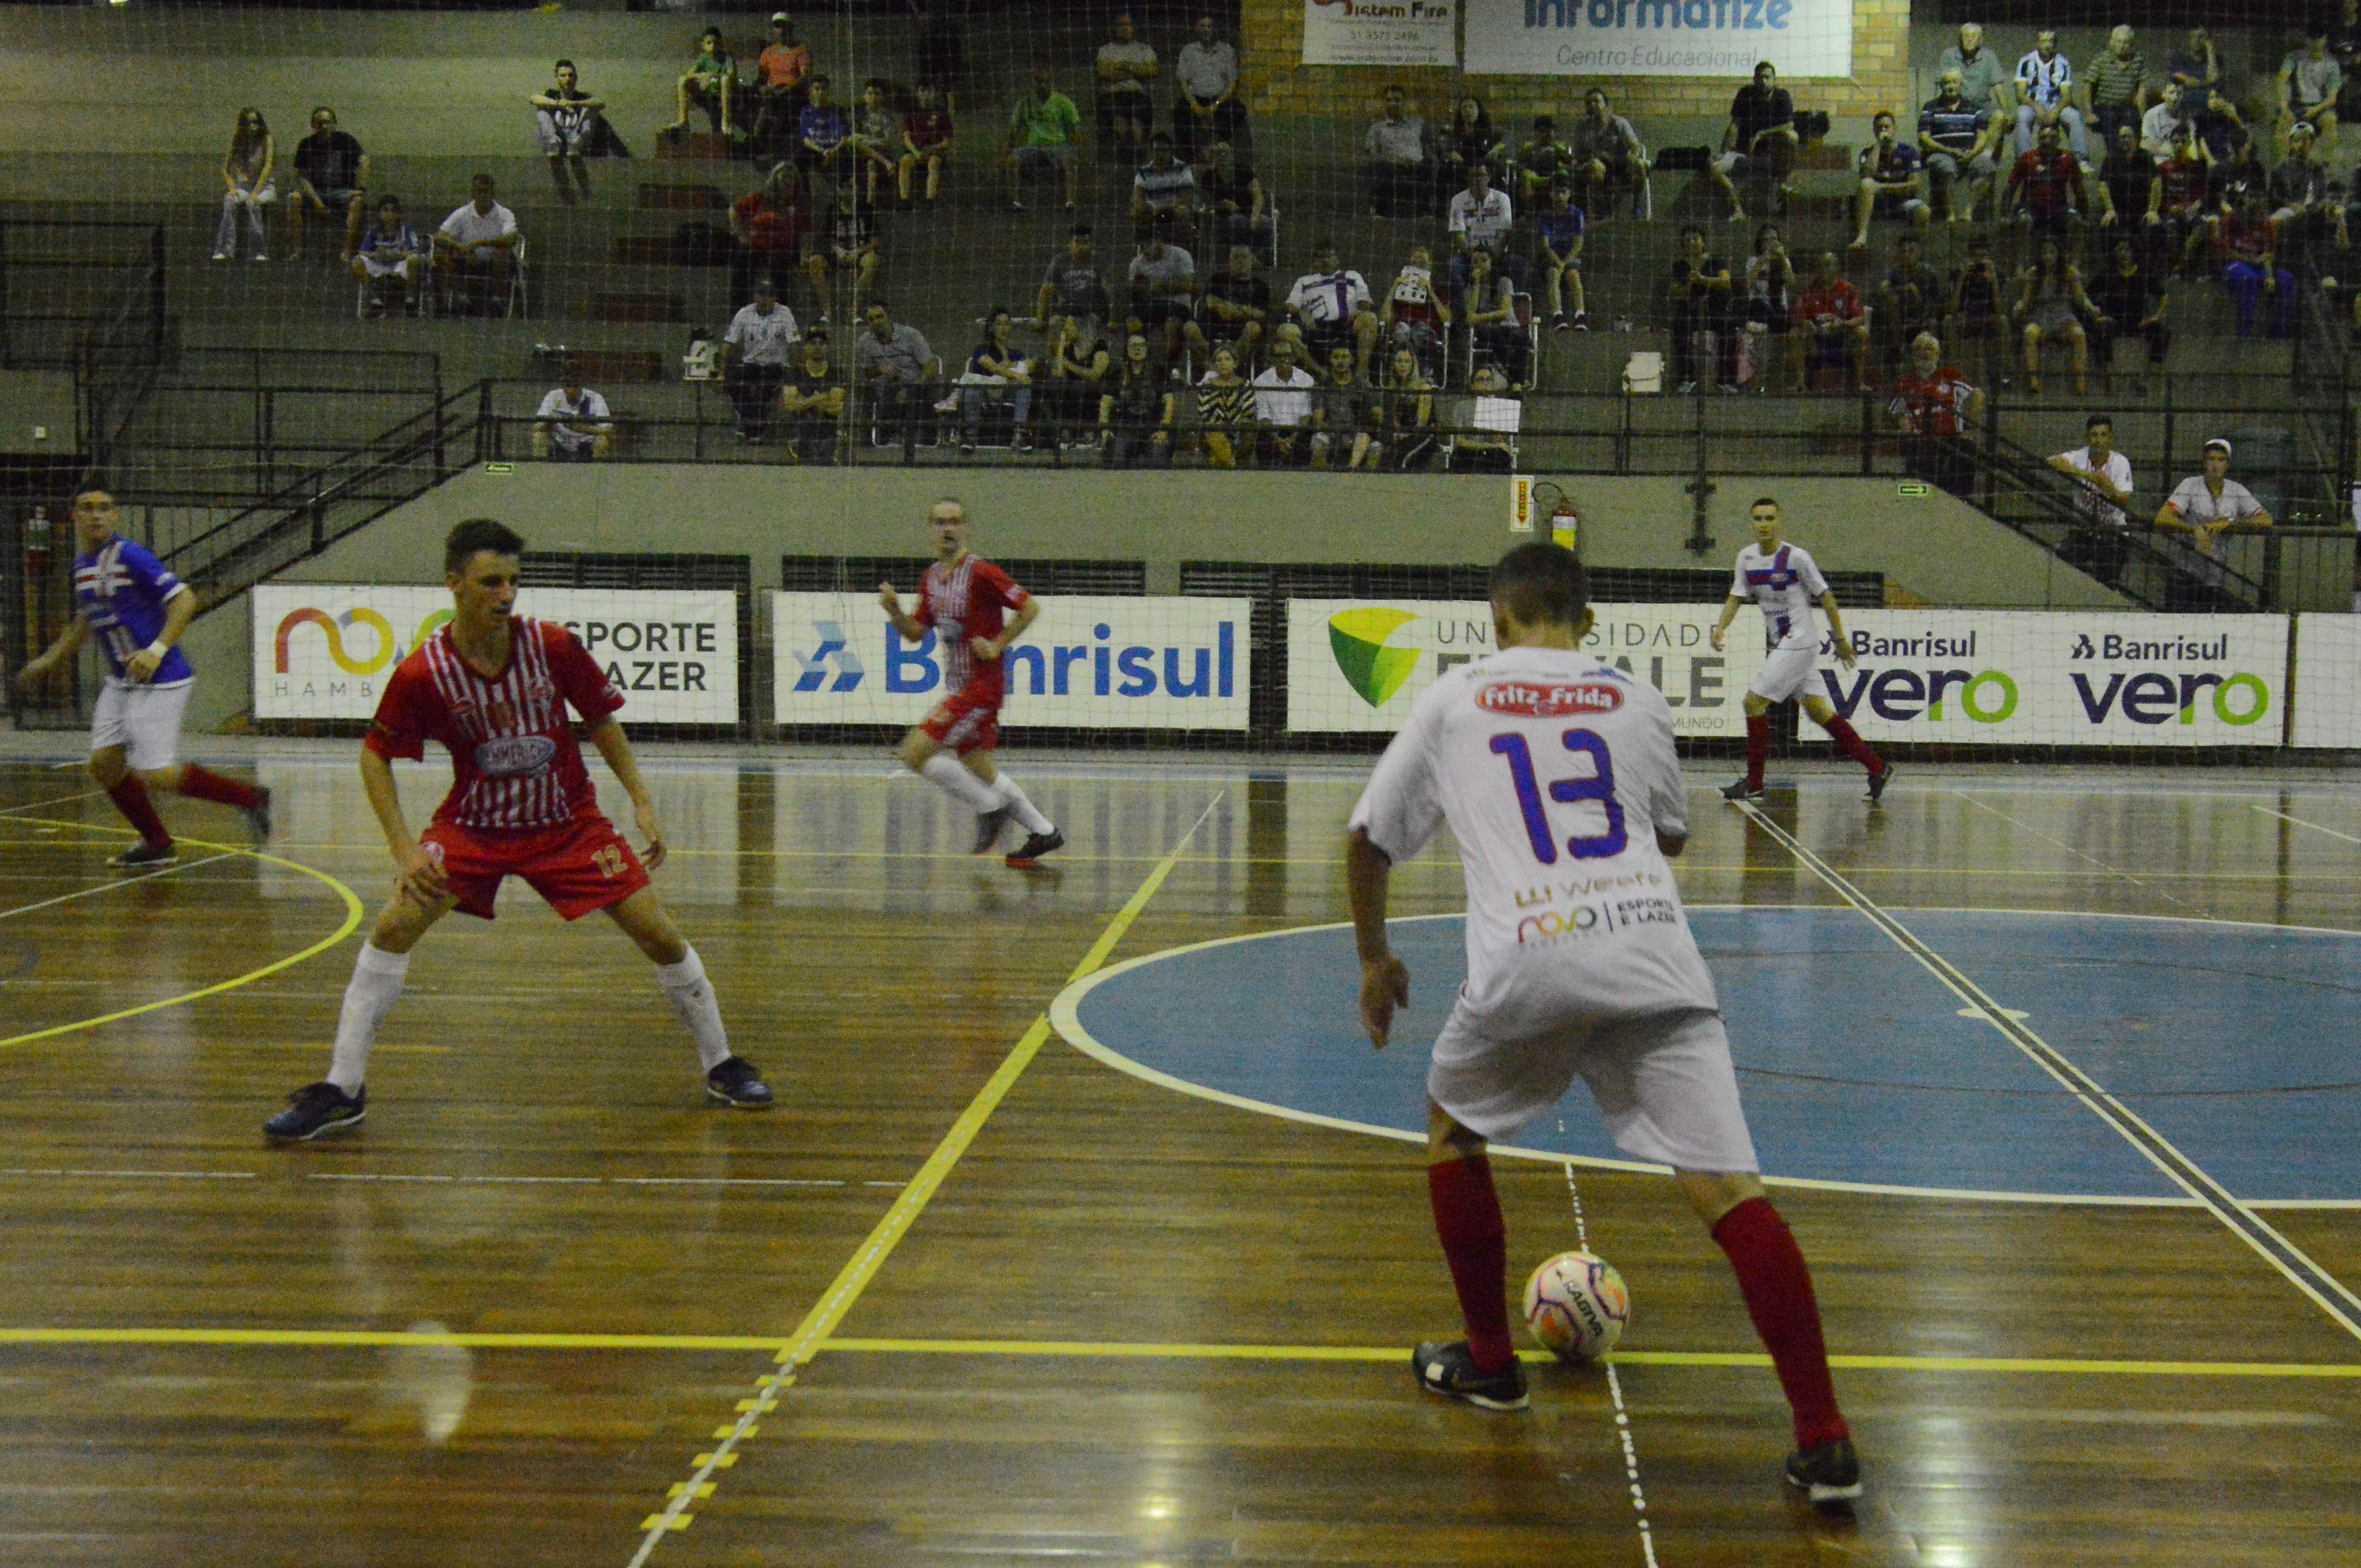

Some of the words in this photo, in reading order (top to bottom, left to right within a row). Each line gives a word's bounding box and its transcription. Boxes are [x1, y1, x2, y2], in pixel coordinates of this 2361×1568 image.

[1412, 1, 1448, 17] Fire
[1557, 44, 1626, 67] Centro
[1633, 46, 1758, 68] Educacional
[885, 620, 1233, 697] Bnrisul
[1851, 630, 1976, 658] Banrisul
[2103, 634, 2227, 661] Banrisul
[606, 661, 707, 691] AZER
[1485, 684, 1540, 707] Fritz
[1550, 686, 1613, 709] Frida
[1818, 668, 2018, 723] vero
[2070, 672, 2269, 726] vero
[1489, 728, 1628, 864] 13
[591, 844, 628, 878] 12
